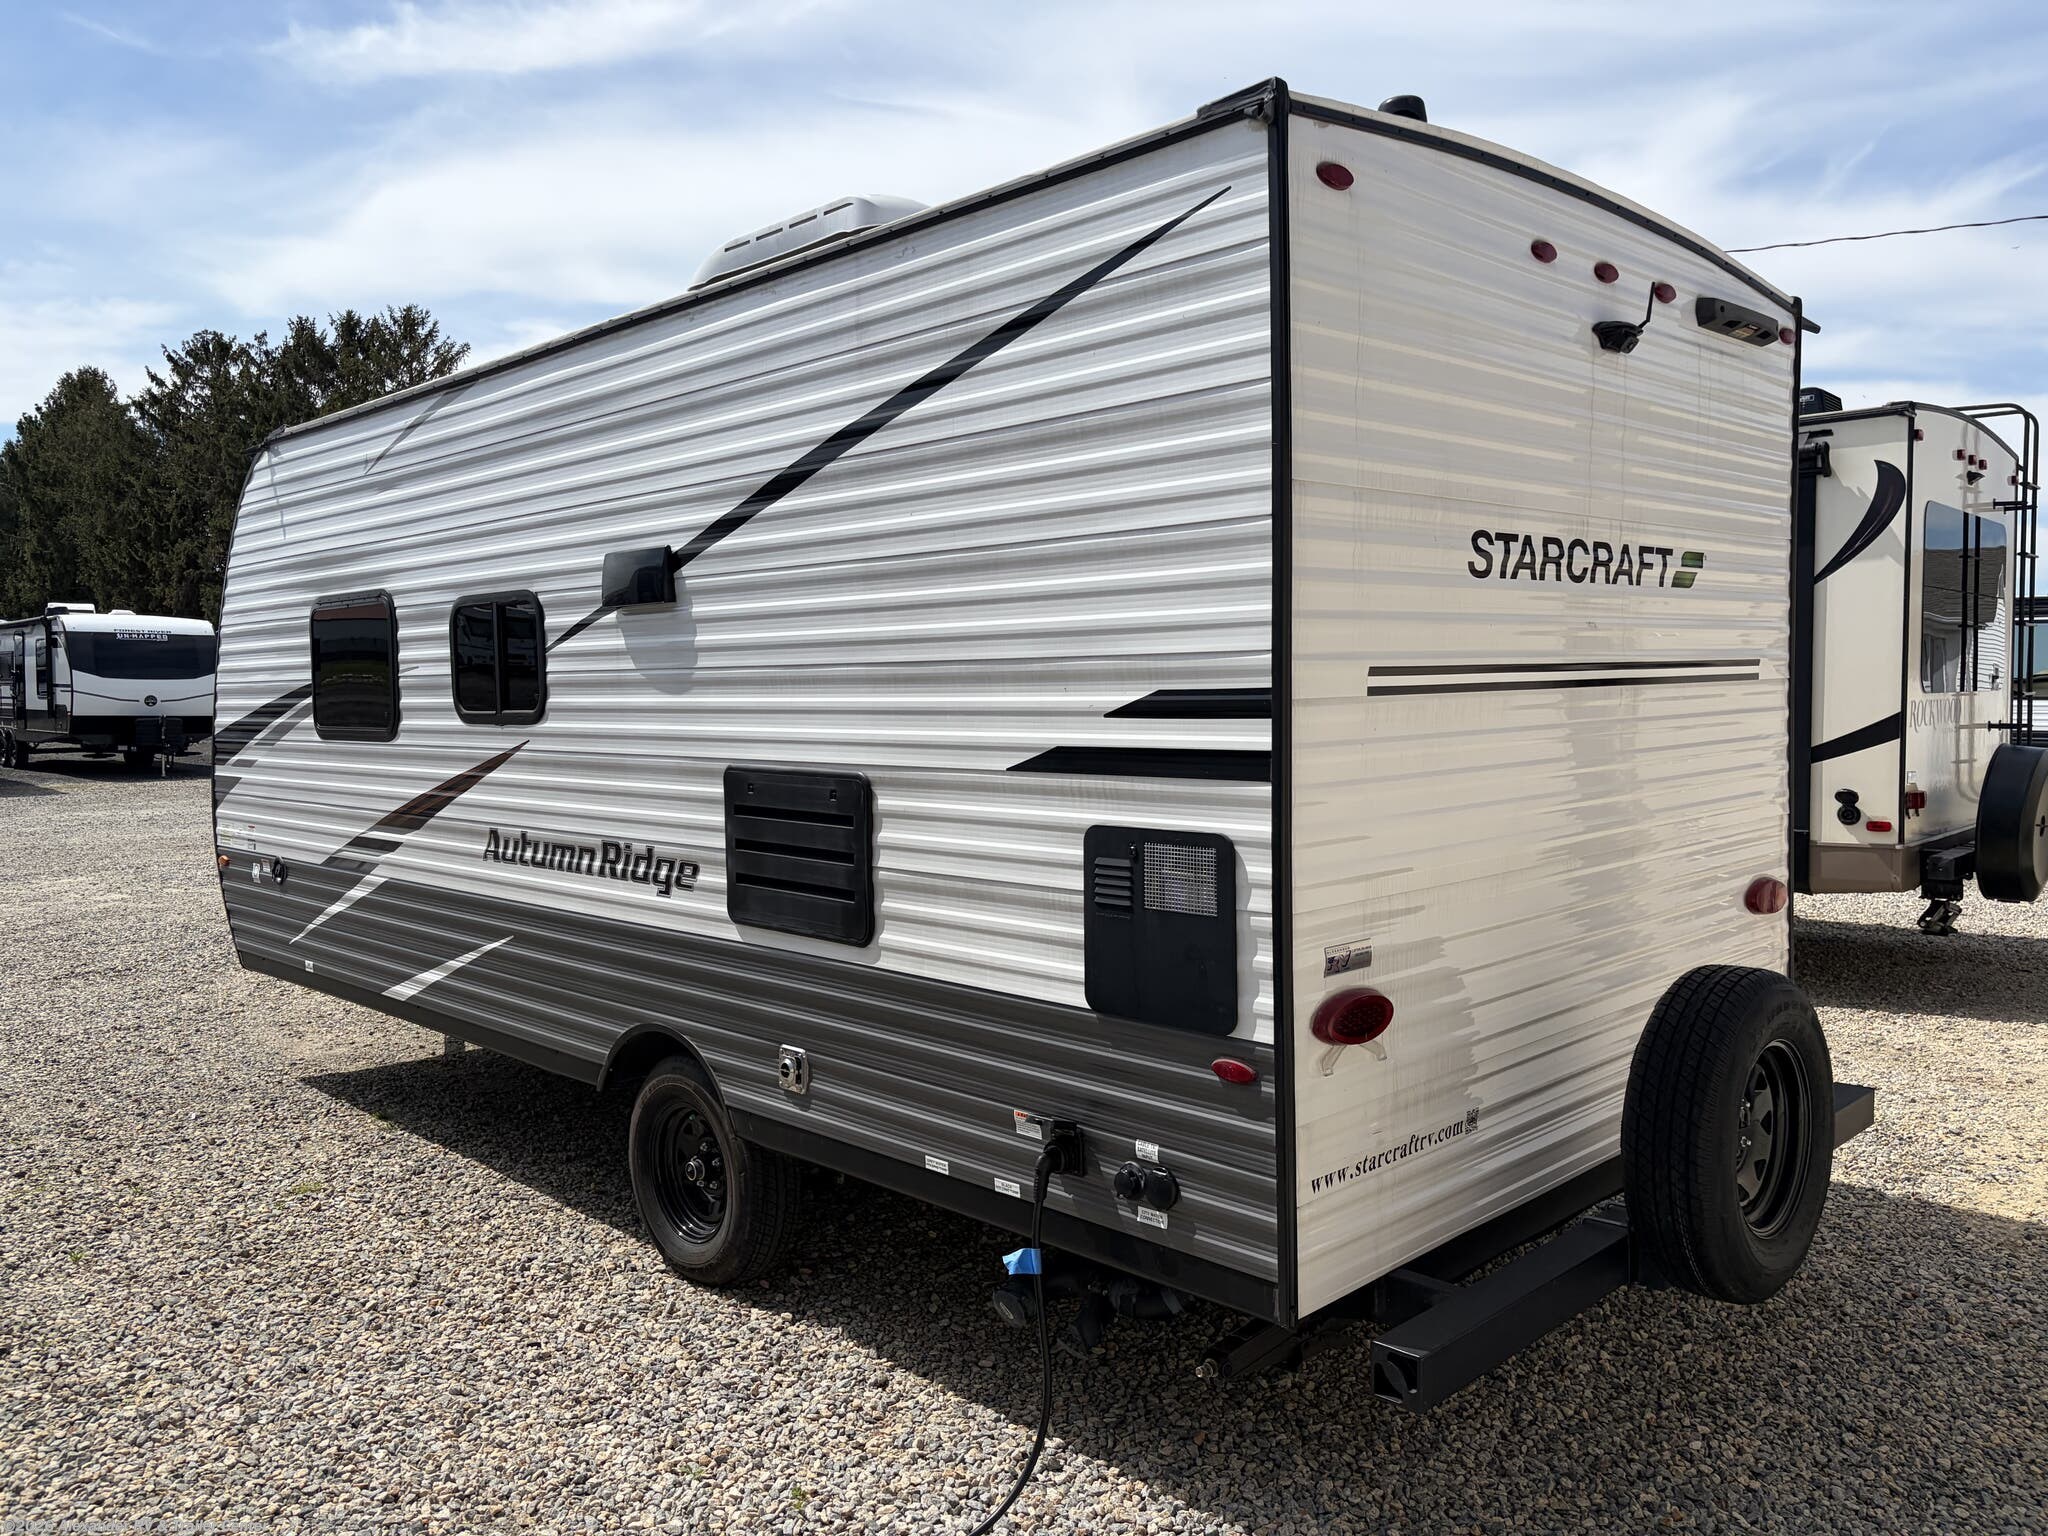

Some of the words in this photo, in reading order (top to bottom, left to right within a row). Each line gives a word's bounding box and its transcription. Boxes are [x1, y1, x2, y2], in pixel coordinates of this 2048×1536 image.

[1468, 529, 1673, 588] STARCRAFT
[1909, 698, 1962, 733] ROCKWOOD
[483, 827, 598, 877] Autumn
[598, 839, 700, 898] Ridge
[1311, 1120, 1465, 1194] www.starcraftrv.com
